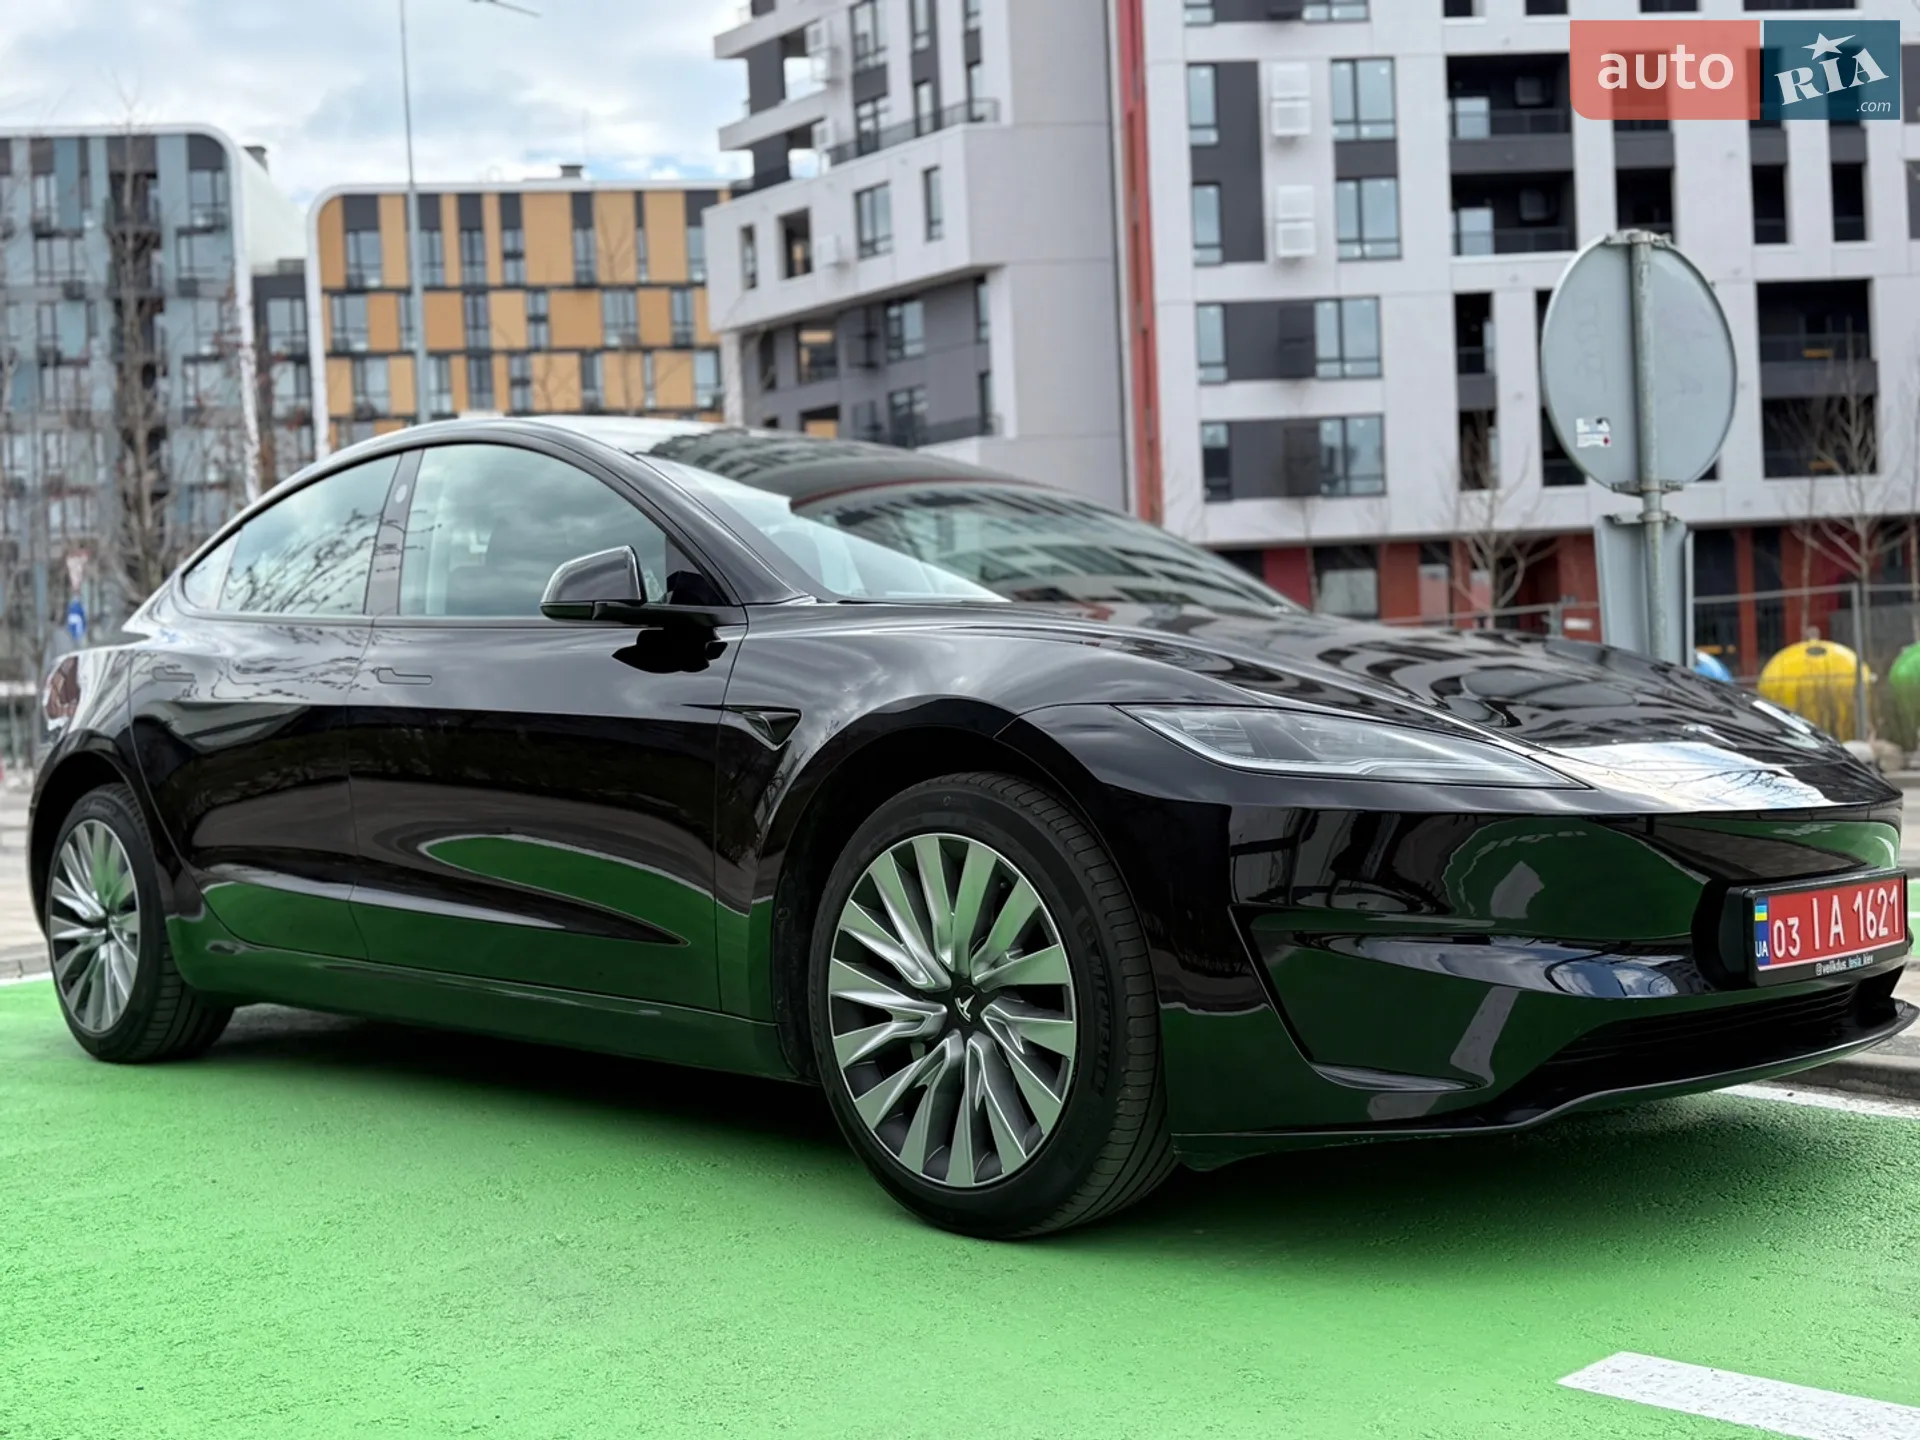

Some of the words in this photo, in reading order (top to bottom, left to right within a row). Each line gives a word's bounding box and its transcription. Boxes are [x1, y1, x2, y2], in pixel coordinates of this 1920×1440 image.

[1755, 941, 1769, 958] UA
[1773, 917, 1800, 958] 03
[1853, 885, 1899, 941] 1621
[1088, 956, 1112, 1097] MICHELIN
